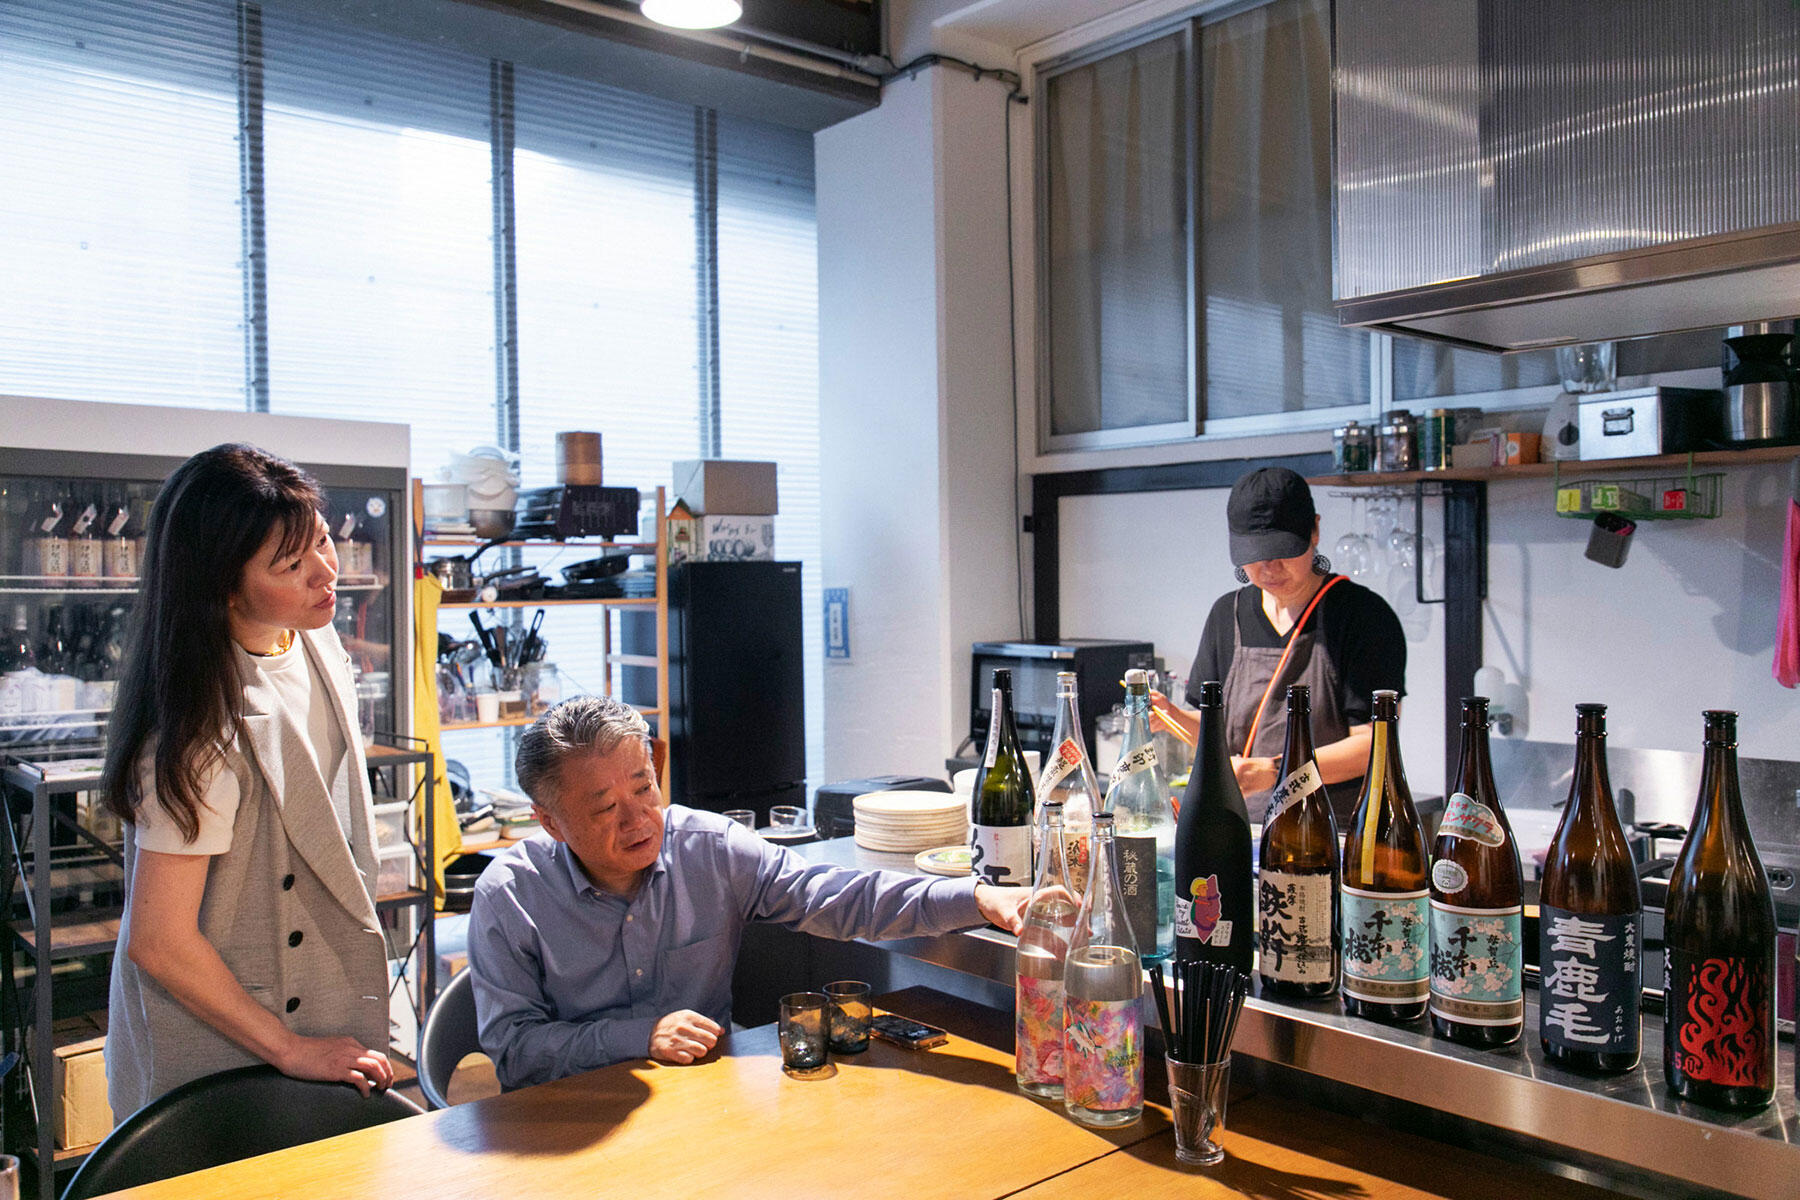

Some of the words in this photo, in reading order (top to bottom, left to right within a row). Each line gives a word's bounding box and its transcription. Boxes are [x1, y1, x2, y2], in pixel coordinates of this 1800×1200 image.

[1123, 849, 1139, 896] 秘蔵の酒
[1345, 910, 1393, 965] 千本桜
[1431, 926, 1477, 982] 千本桜
[1623, 922, 1636, 973] 大麦焼酎
[1544, 916, 1617, 1044] 青鹿毛
[1614, 1005, 1627, 1043] あおかげ
